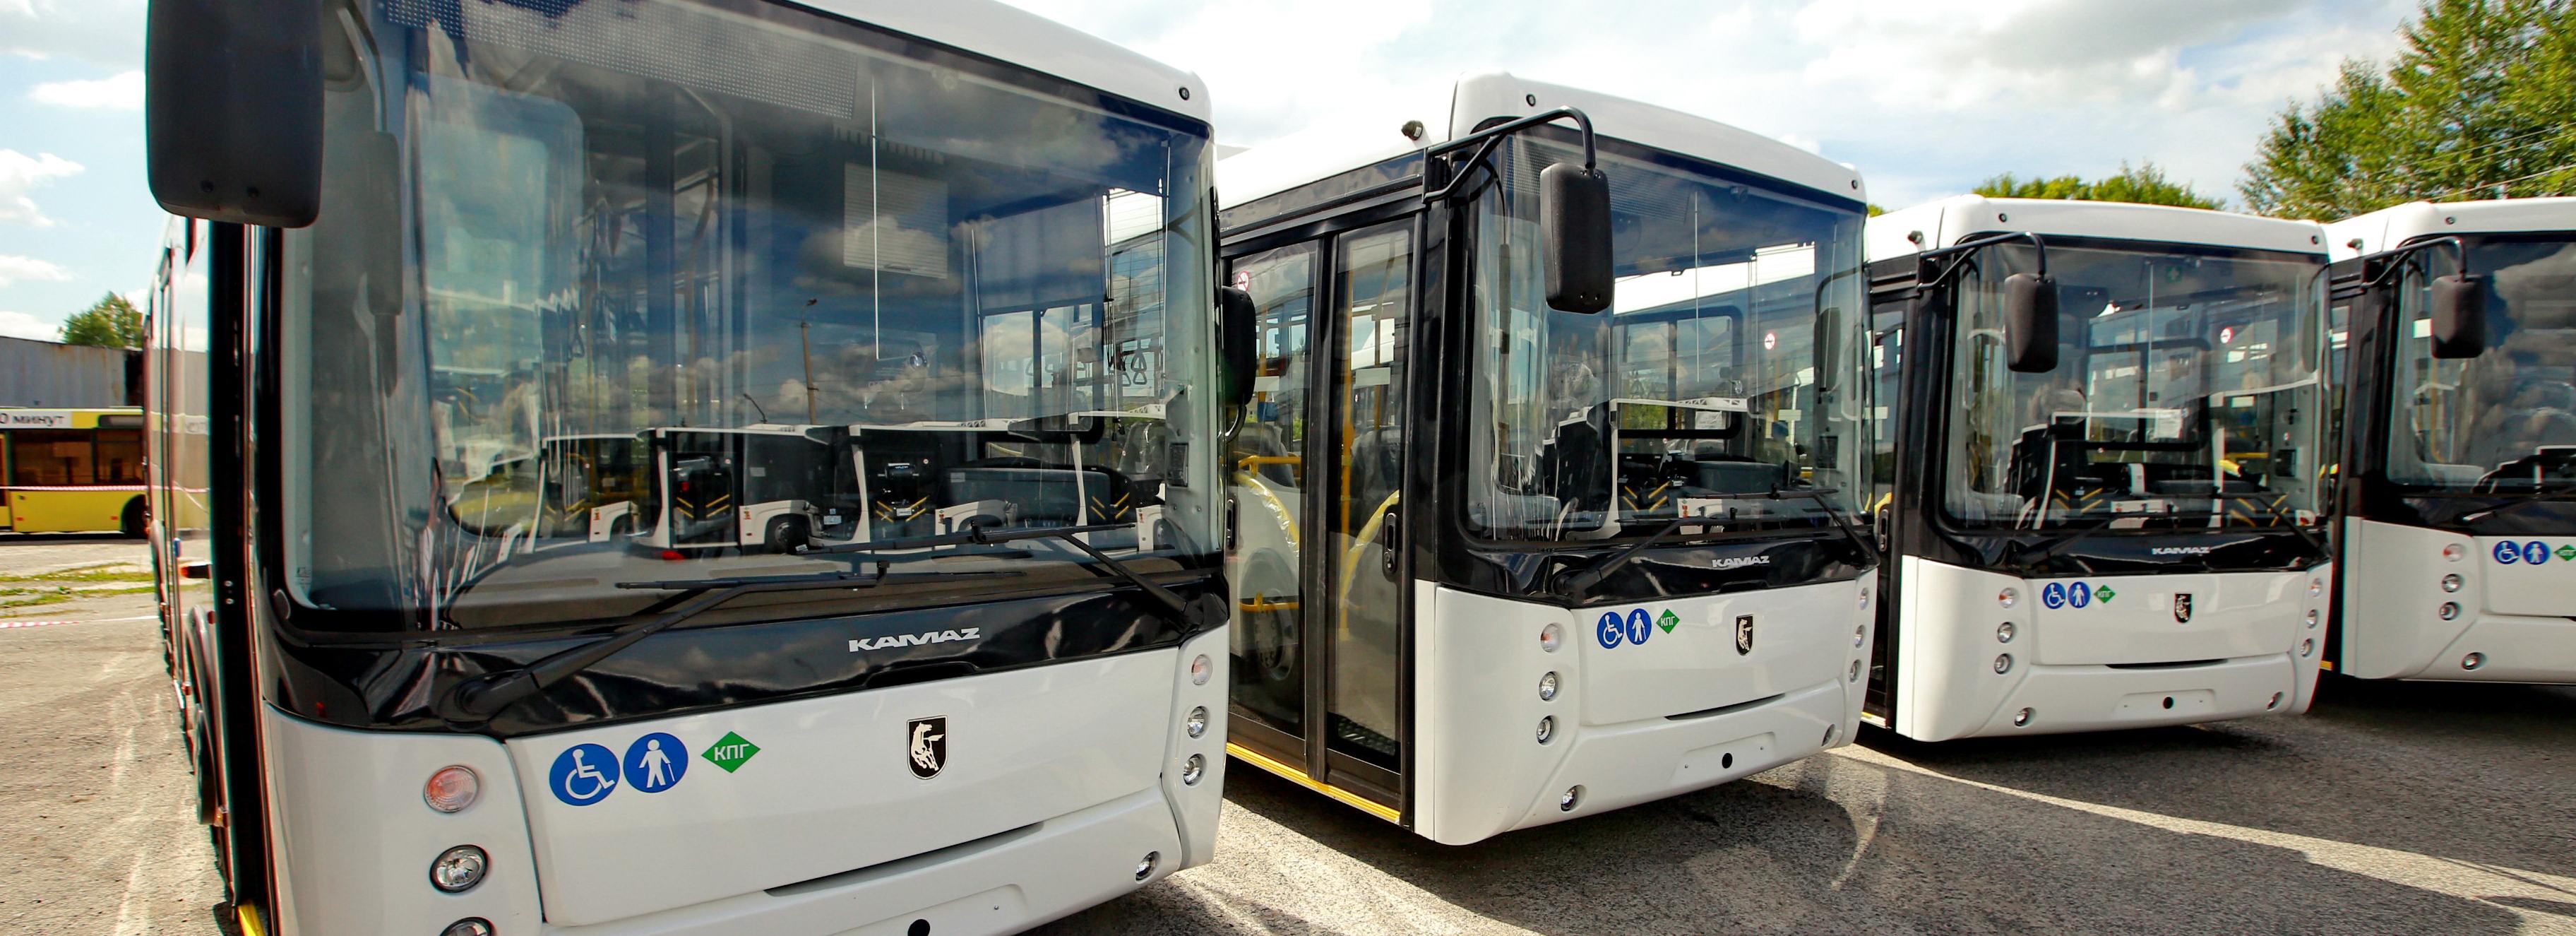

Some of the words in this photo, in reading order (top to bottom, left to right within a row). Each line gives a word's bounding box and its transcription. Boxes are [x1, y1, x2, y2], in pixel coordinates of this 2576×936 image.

[13, 415, 64, 427] минут
[1712, 555, 1770, 567] KAMAZ
[1661, 616, 1675, 627] КПГ
[849, 627, 980, 652] KAMAZ
[715, 743, 749, 761] КПГ
